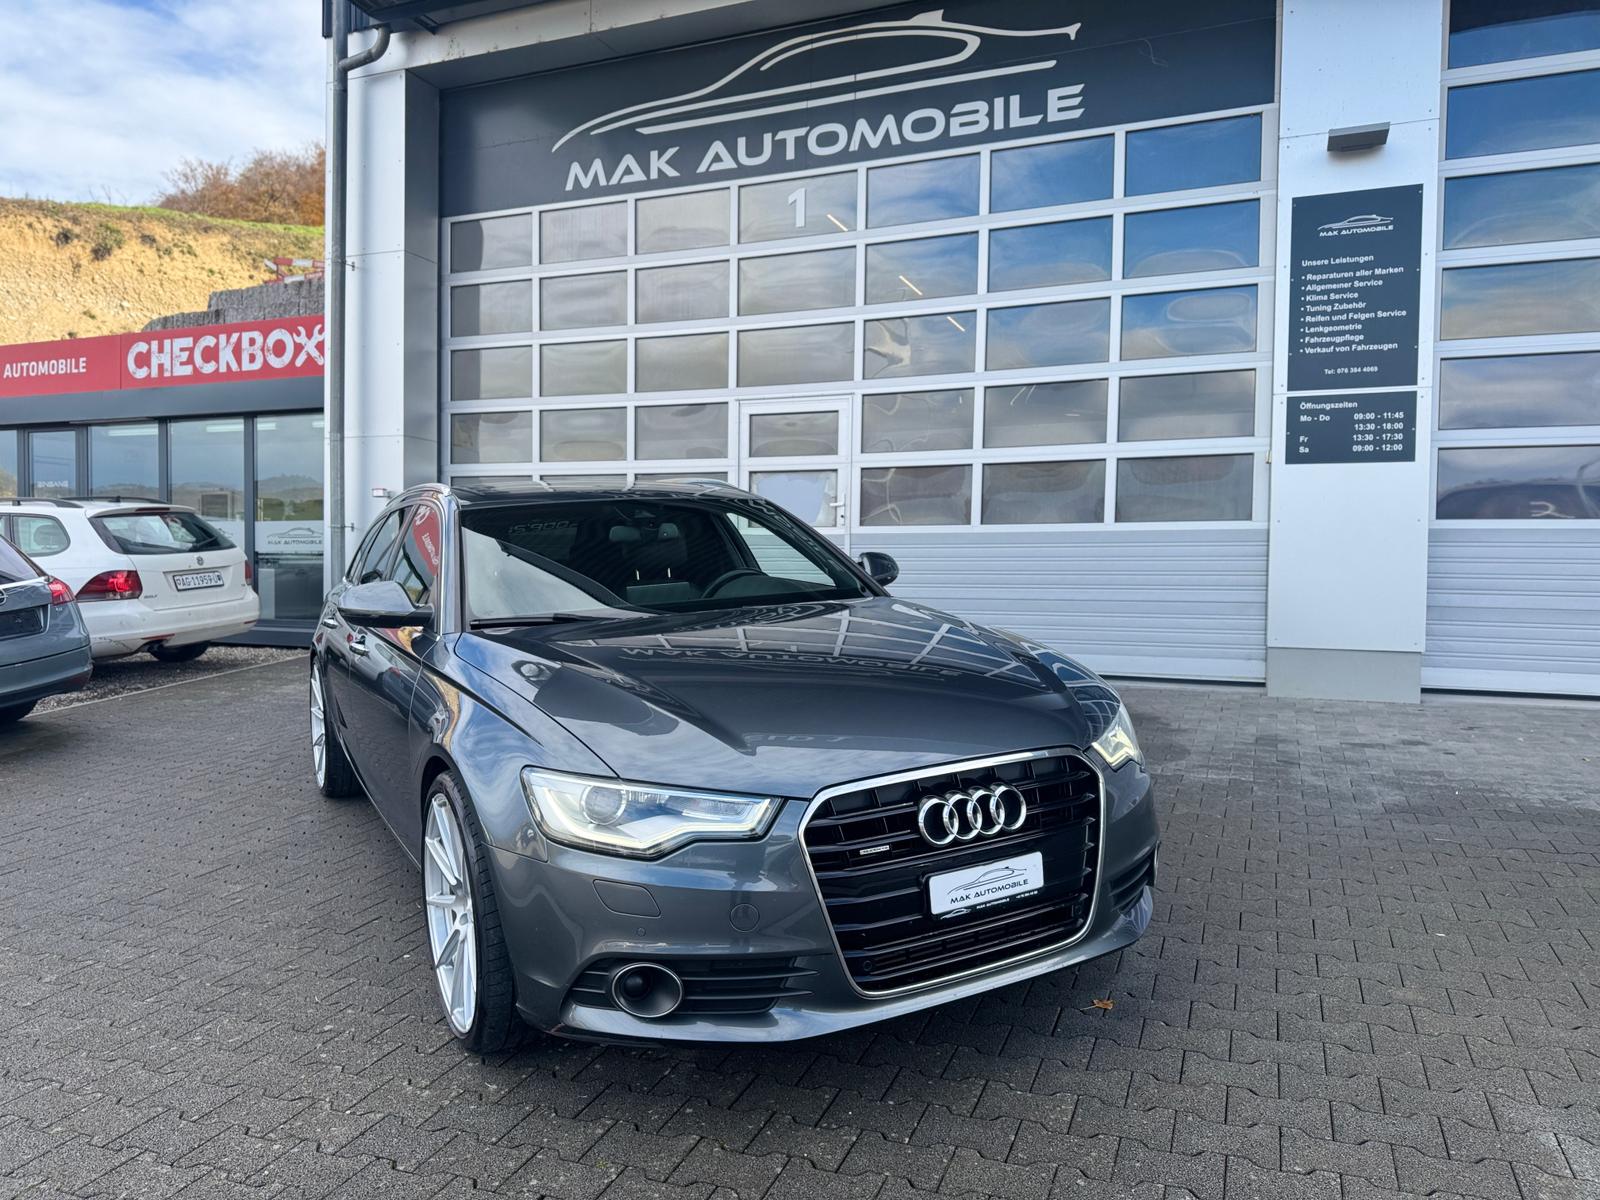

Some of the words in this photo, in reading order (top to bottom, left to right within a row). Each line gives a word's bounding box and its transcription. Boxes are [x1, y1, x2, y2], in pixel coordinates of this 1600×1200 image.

[565, 145, 680, 192] MAK
[696, 83, 1086, 174] AUTOMOBILE
[788, 187, 806, 228] 1
[1340, 225, 1394, 235] AUTOMOBILE
[1302, 259, 1329, 267] Unsere
[1330, 255, 1375, 264] Leistungen
[1306, 272, 1354, 281] Reparaturen
[1355, 269, 1373, 277] aller
[1375, 266, 1404, 275] Marken
[1306, 282, 1352, 291] Allgemeiner
[1353, 279, 1383, 288] Service
[1306, 293, 1328, 302] Klima
[1329, 291, 1359, 300] Service
[1306, 304, 1332, 312] Tuning
[1333, 301, 1366, 310] Zubehör
[1348, 311, 1375, 321] Felgen
[1377, 309, 1407, 318] Service
[1305, 323, 1362, 333] Lenkgeometrie
[1305, 333, 1364, 343] Fahrzeugpflege
[127, 324, 325, 379] CHECKBOX
[1304, 345, 1334, 354] Verkauf
[1351, 342, 1398, 352] Fahrzeugen
[3, 357, 87, 379] AUTOMOBILE
[1299, 401, 1358, 411] Öffnungszeiten
[1382, 422, 1404, 430] 18:00
[1382, 443, 1403, 451] 12:00
[950, 893, 971, 905] MAK
[973, 878, 1029, 898] AUTOMOBILE
